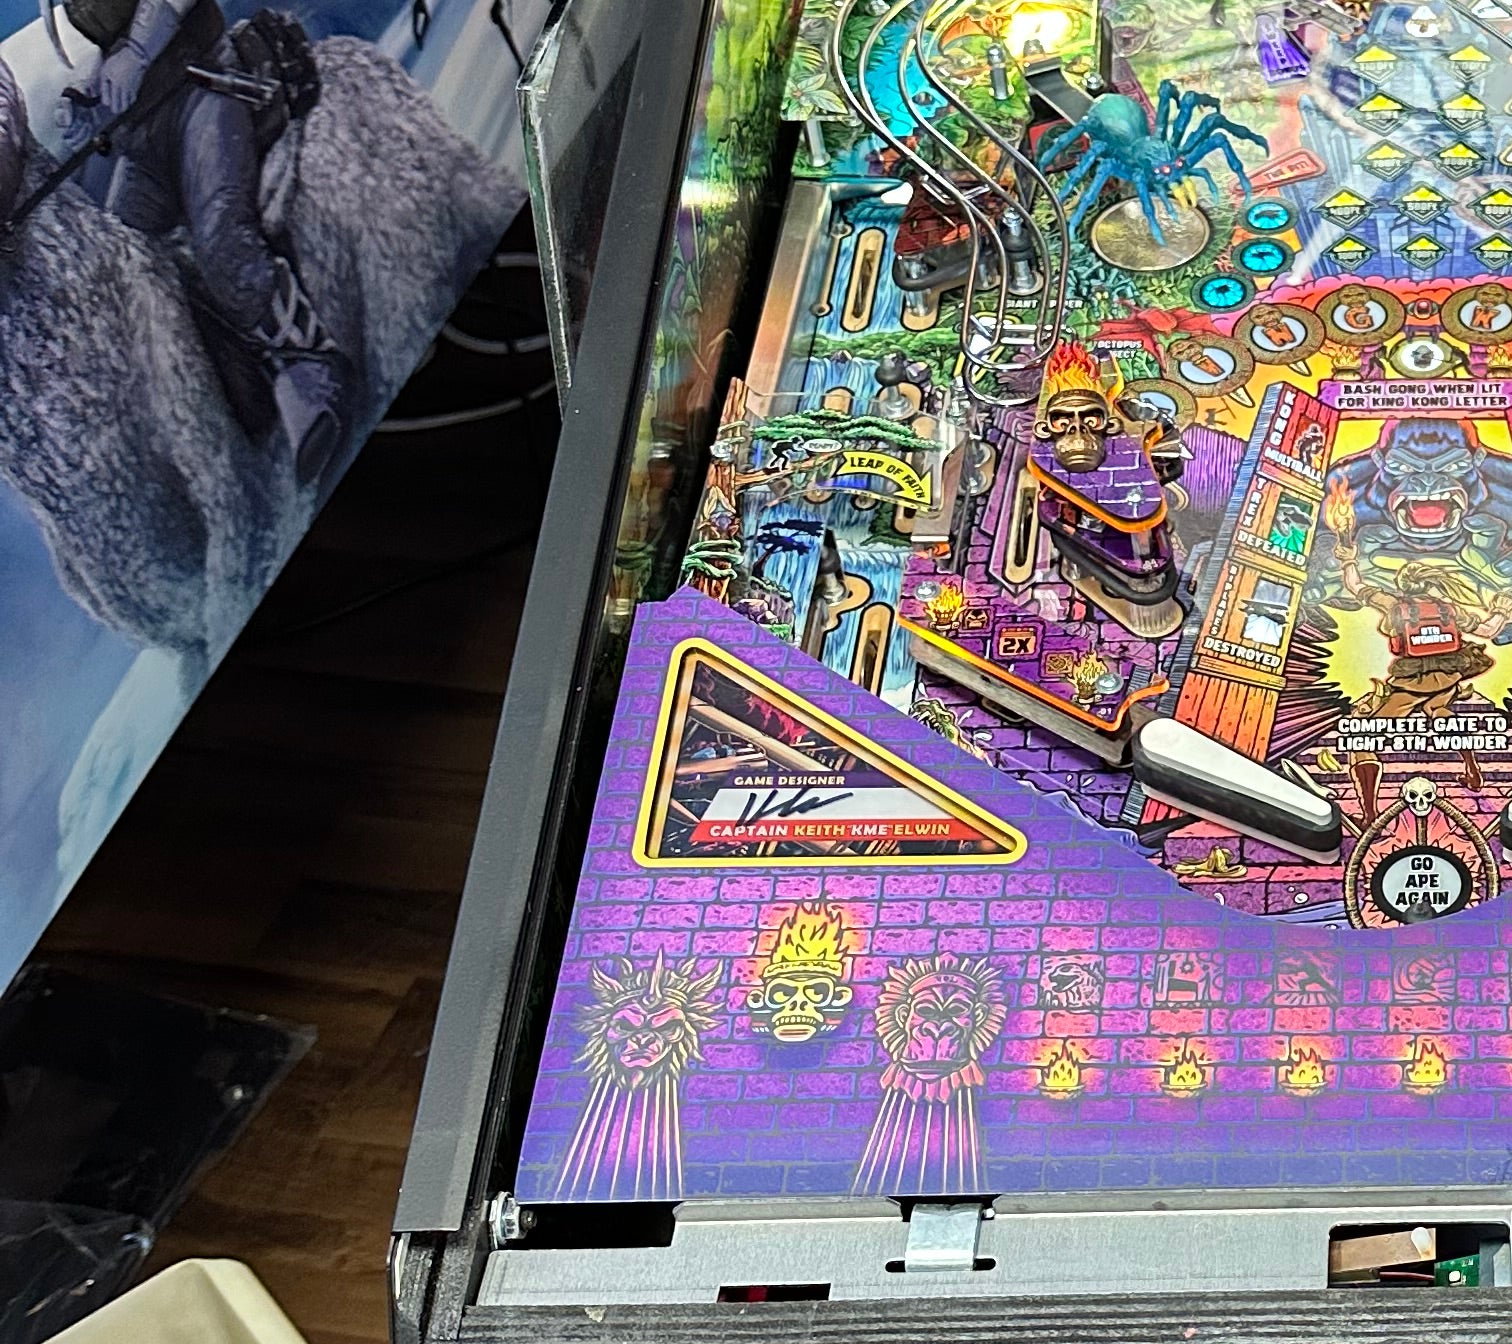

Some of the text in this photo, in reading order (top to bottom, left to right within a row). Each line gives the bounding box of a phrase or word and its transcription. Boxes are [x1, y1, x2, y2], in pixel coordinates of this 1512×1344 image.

[1098, 341, 1142, 349] OCTOPUS
[1343, 383, 1502, 394] BASH GONG WHEN LIT
[1338, 396, 1508, 407] FOR KING KONG LETTER
[1264, 446, 1322, 483] MULTIBALL
[850, 457, 926, 498] LEAP OF FAITH
[1237, 530, 1306, 566] DEFEATED
[1211, 565, 1238, 636] BIPLANES
[1002, 637, 1031, 654] 2X
[1203, 637, 1281, 668] DESTROYED
[1338, 717, 1507, 733] COMPLETE GATE TO
[1338, 735, 1507, 750] LIGHT 8TH WONDER
[734, 775, 845, 786] GAME DESIGNER
[709, 824, 788, 837] CAPTAIN
[793, 823, 845, 837] KEITH
[893, 823, 950, 836] ELWIN
[1411, 857, 1434, 871] GO
[1405, 874, 1439, 888] APE
[1395, 891, 1449, 906] AGAIN
